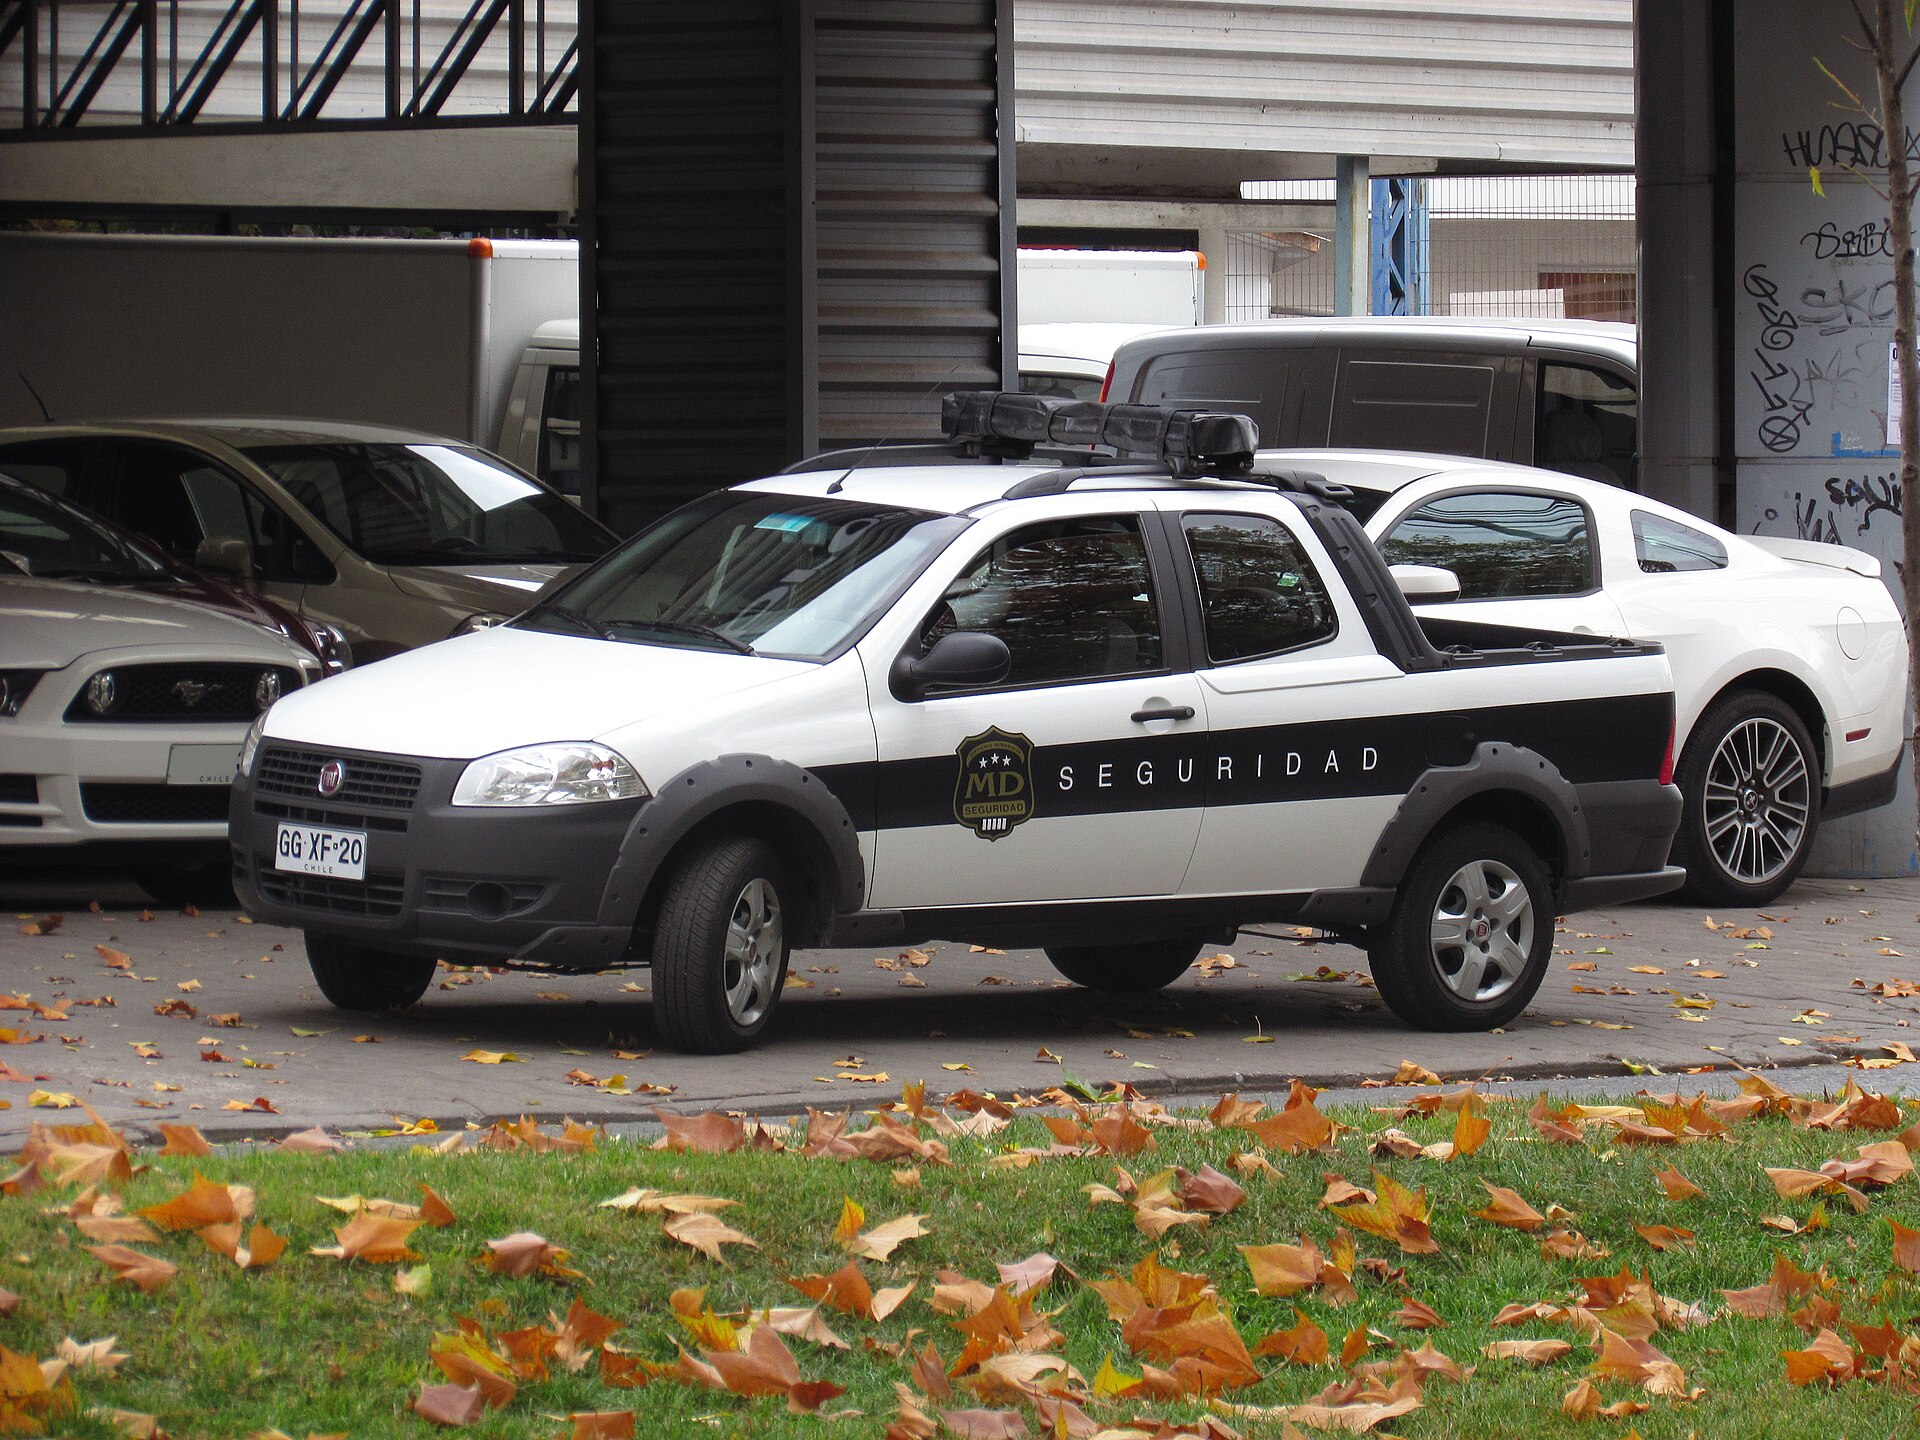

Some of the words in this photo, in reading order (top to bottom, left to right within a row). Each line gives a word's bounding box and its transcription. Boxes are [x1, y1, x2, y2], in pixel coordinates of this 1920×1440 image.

[1058, 747, 1378, 791] SEGURIDAD
[199, 775, 230, 783] CHILE
[964, 771, 1025, 799] MD
[965, 803, 1024, 816] SEGURIDAD
[303, 863, 334, 874] CHILE
